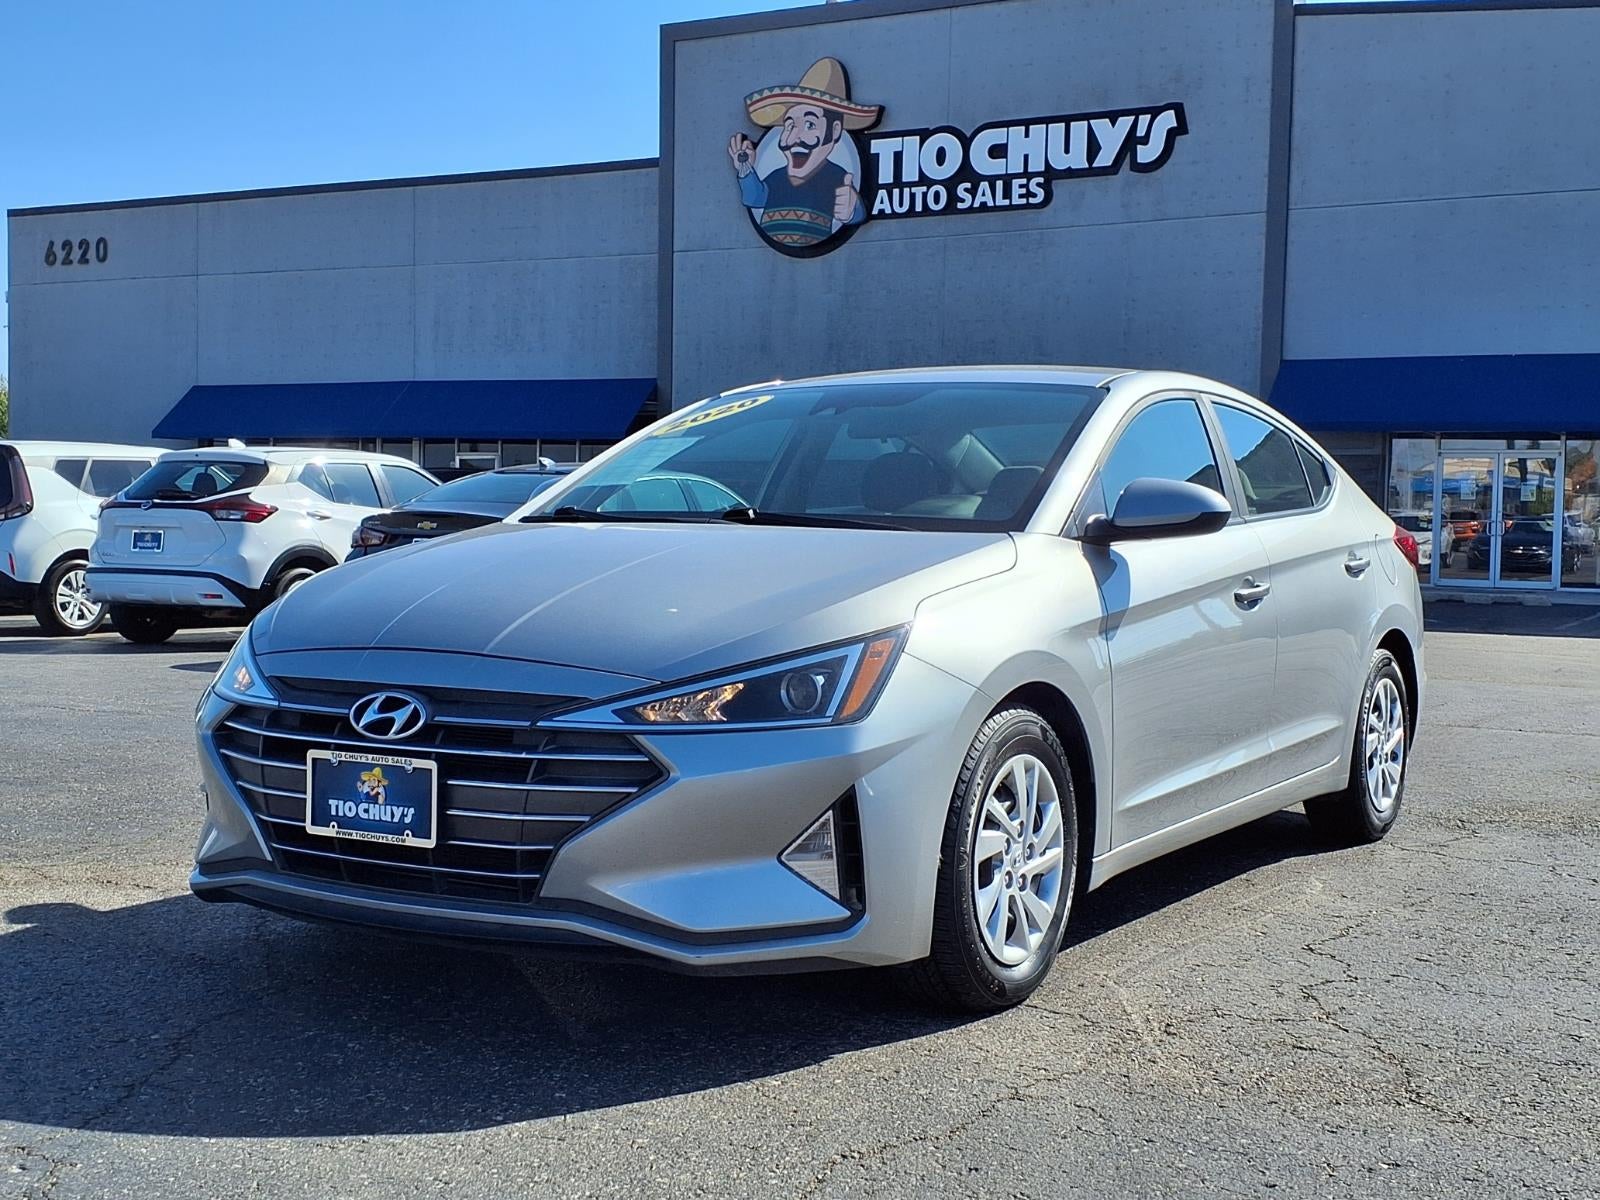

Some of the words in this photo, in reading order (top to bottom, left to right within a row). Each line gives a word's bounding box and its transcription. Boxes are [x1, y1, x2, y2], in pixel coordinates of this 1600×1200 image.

[870, 132, 963, 185] TIO
[969, 109, 1178, 178] CHUY'S
[871, 184, 948, 216] AUTO
[956, 176, 1046, 210] SALES
[44, 236, 108, 267] 6220
[663, 398, 760, 433] 2020
[371, 755, 390, 764] AUTO
[391, 758, 413, 766] SALES
[335, 830, 407, 844] WWW.TIOCHUYS.COM
